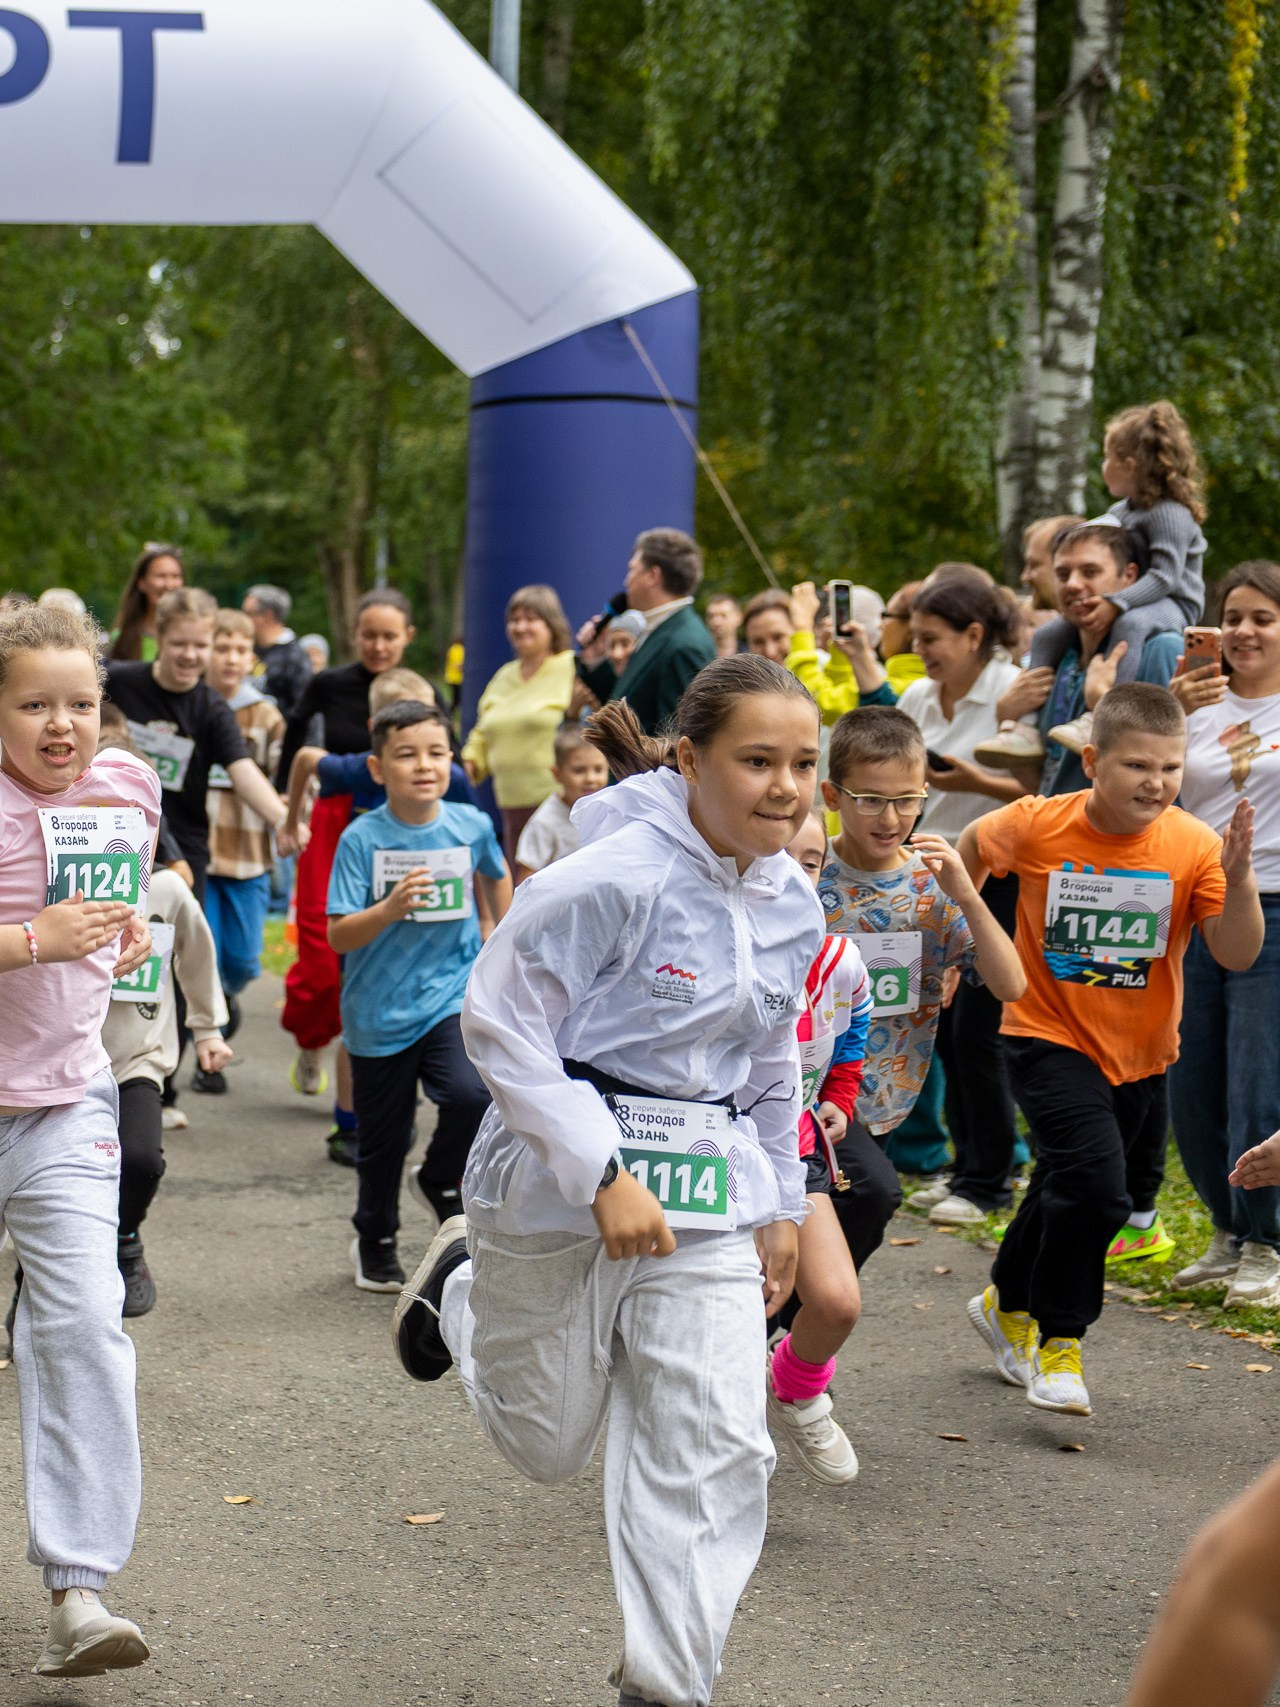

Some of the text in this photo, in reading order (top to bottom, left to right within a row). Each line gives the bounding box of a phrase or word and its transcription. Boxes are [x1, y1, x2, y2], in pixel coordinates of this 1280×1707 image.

[51, 815, 98, 832] 8 городов
[54, 836, 89, 846] КАЗАНЬ
[63, 862, 133, 899] 1124
[1060, 877, 1113, 893] 8 городов
[412, 882, 455, 909] 31
[1059, 893, 1099, 903] КАЗАНЬ
[1063, 913, 1149, 944] 1144
[1111, 973, 1147, 987] FILA
[620, 1104, 686, 1127] 8 городов
[632, 1104, 686, 1115] серия забегов
[629, 1159, 718, 1206] 1114
